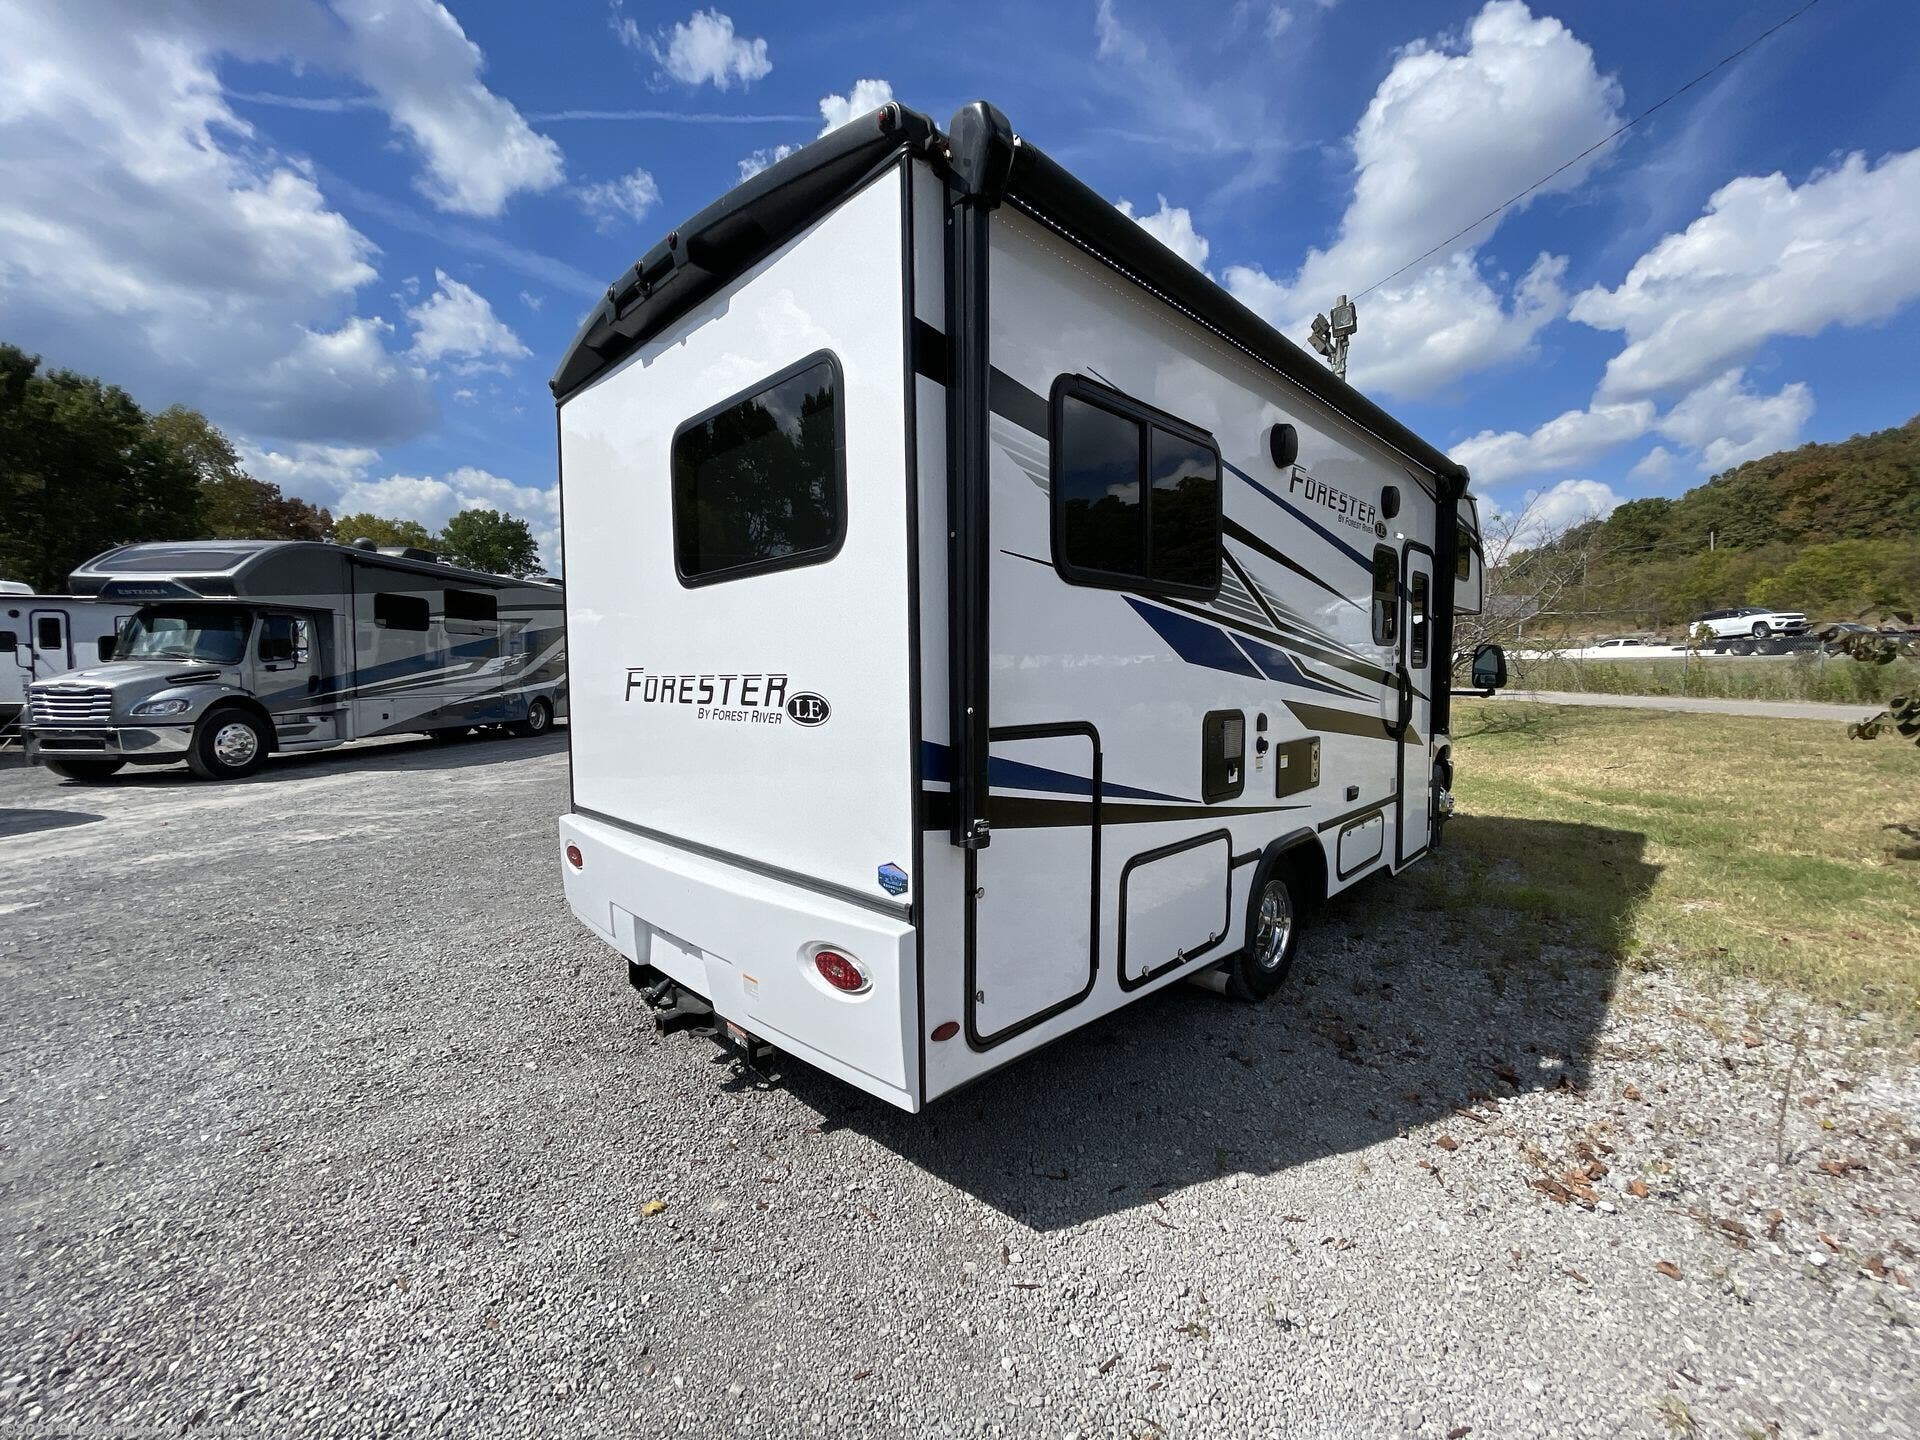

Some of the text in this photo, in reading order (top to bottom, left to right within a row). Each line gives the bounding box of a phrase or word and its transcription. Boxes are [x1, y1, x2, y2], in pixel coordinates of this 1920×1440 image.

[1289, 463, 1376, 524] FORESTER
[625, 667, 788, 708] FORESTER
[712, 709, 749, 722] FOREST
[750, 709, 783, 725] RIVER
[793, 698, 824, 722] LE
